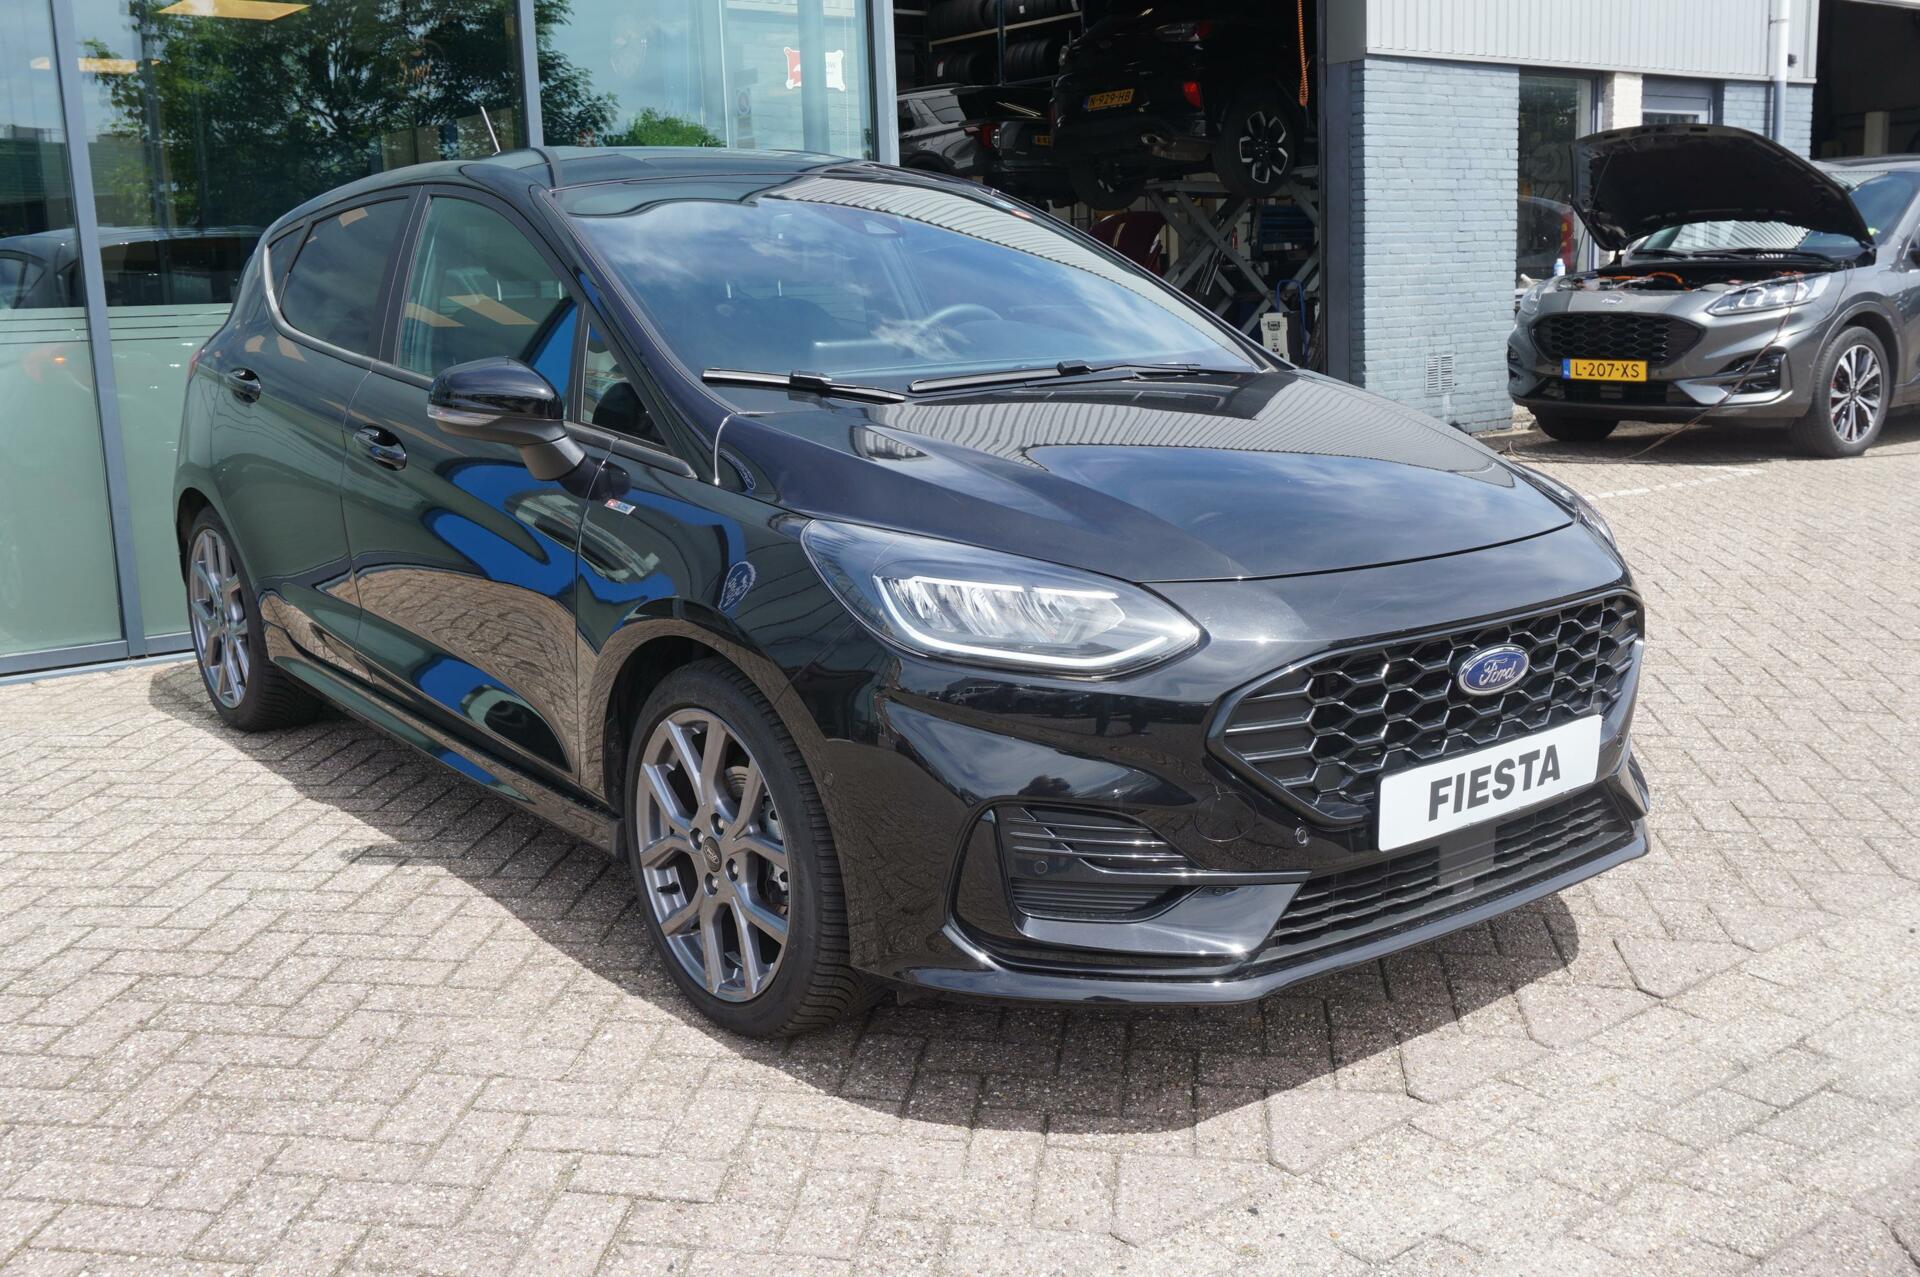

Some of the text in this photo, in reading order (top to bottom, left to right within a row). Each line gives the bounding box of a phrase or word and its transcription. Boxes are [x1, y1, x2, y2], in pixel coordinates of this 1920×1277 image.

[1575, 362, 1640, 378] L-207-XS
[1479, 657, 1517, 686] Ford
[1428, 744, 1561, 822] FIESTA
